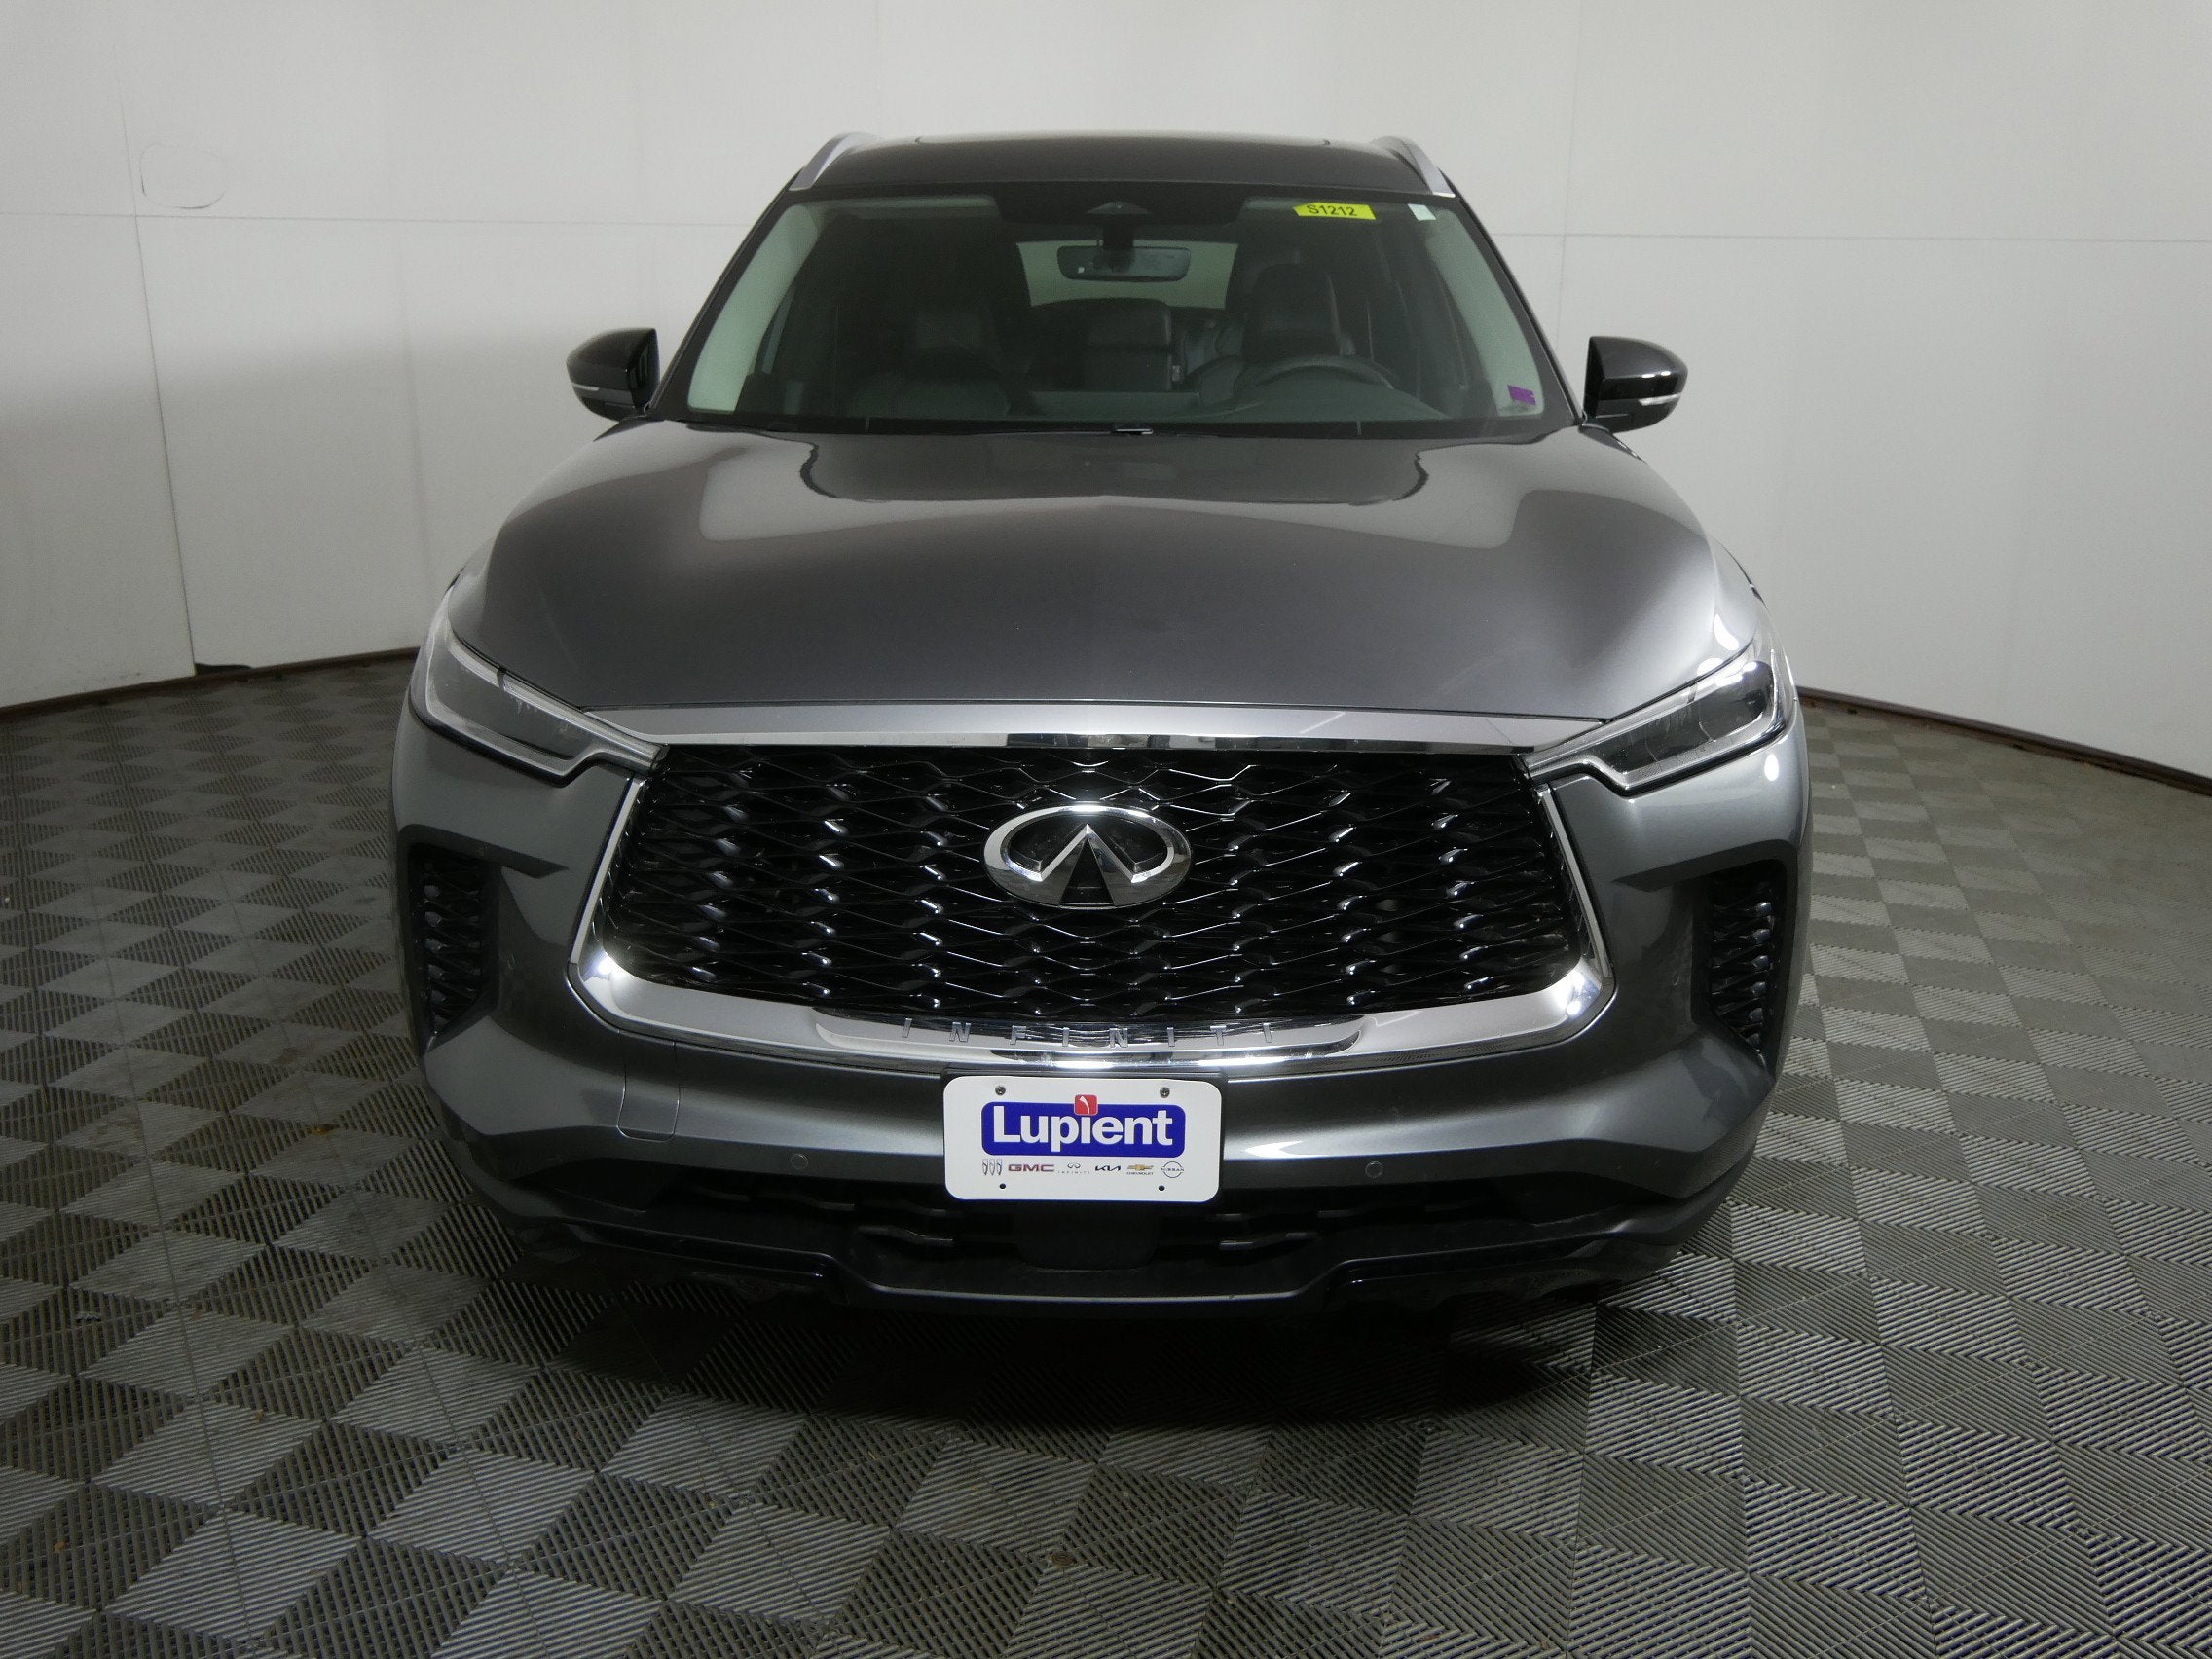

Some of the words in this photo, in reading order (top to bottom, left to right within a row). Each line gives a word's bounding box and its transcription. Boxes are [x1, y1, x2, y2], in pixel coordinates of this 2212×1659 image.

[1307, 203, 1358, 217] S1212
[902, 1017, 1273, 1049] INFINITI
[993, 1104, 1173, 1153] Lupient
[1008, 1163, 1054, 1172] GMC
